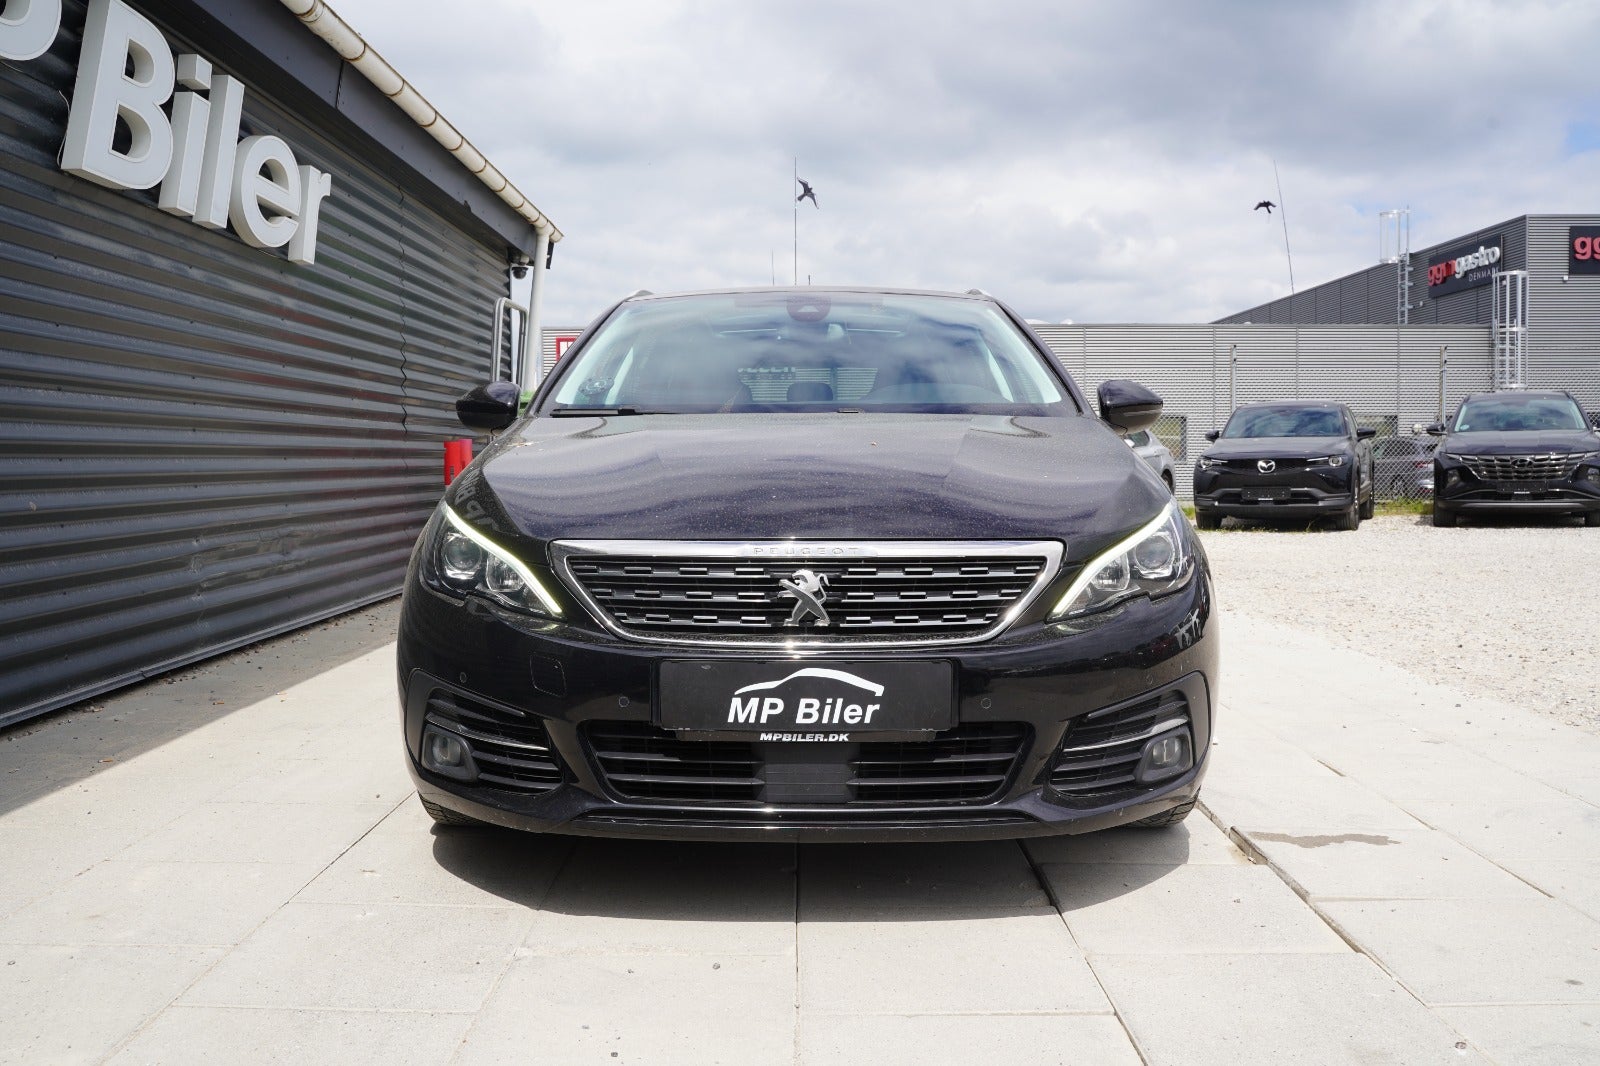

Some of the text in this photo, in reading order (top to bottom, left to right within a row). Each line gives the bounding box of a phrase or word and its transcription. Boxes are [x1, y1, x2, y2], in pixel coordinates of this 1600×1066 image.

[61, 0, 331, 264] Biler
[753, 547, 859, 555] PEUGEOT
[727, 697, 880, 724] MP Biler
[759, 732, 849, 742] MPBILER.DK
